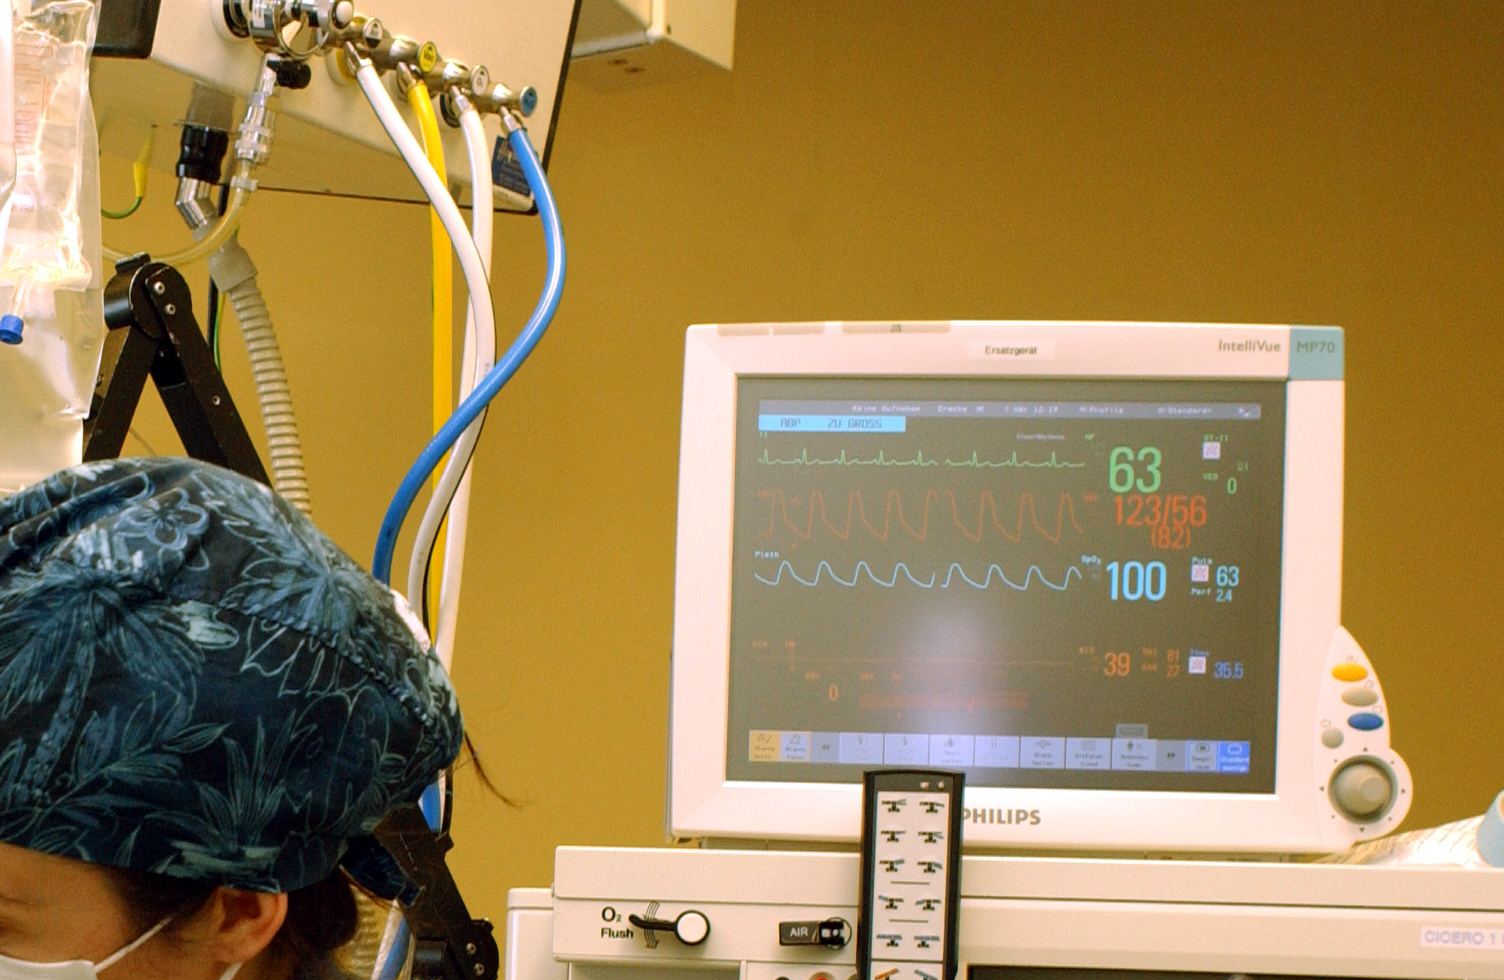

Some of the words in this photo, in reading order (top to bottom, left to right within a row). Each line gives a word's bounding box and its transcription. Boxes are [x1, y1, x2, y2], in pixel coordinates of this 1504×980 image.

[1218, 339, 1281, 353] IntelliVue
[1297, 341, 1336, 354] MP70
[848, 419, 882, 429] GROSS
[1108, 446, 1162, 493] 63
[1114, 494, 1207, 527] 123/56
[1151, 525, 1191, 550] (82)
[1106, 561, 1167, 601] 100
[1216, 565, 1240, 587] 63
[1104, 652, 1131, 677] 39
[963, 808, 1041, 825] PHILIPS
[601, 927, 634, 939] Flush
[790, 926, 808, 938] AIR
[1425, 930, 1484, 945] CICERO
